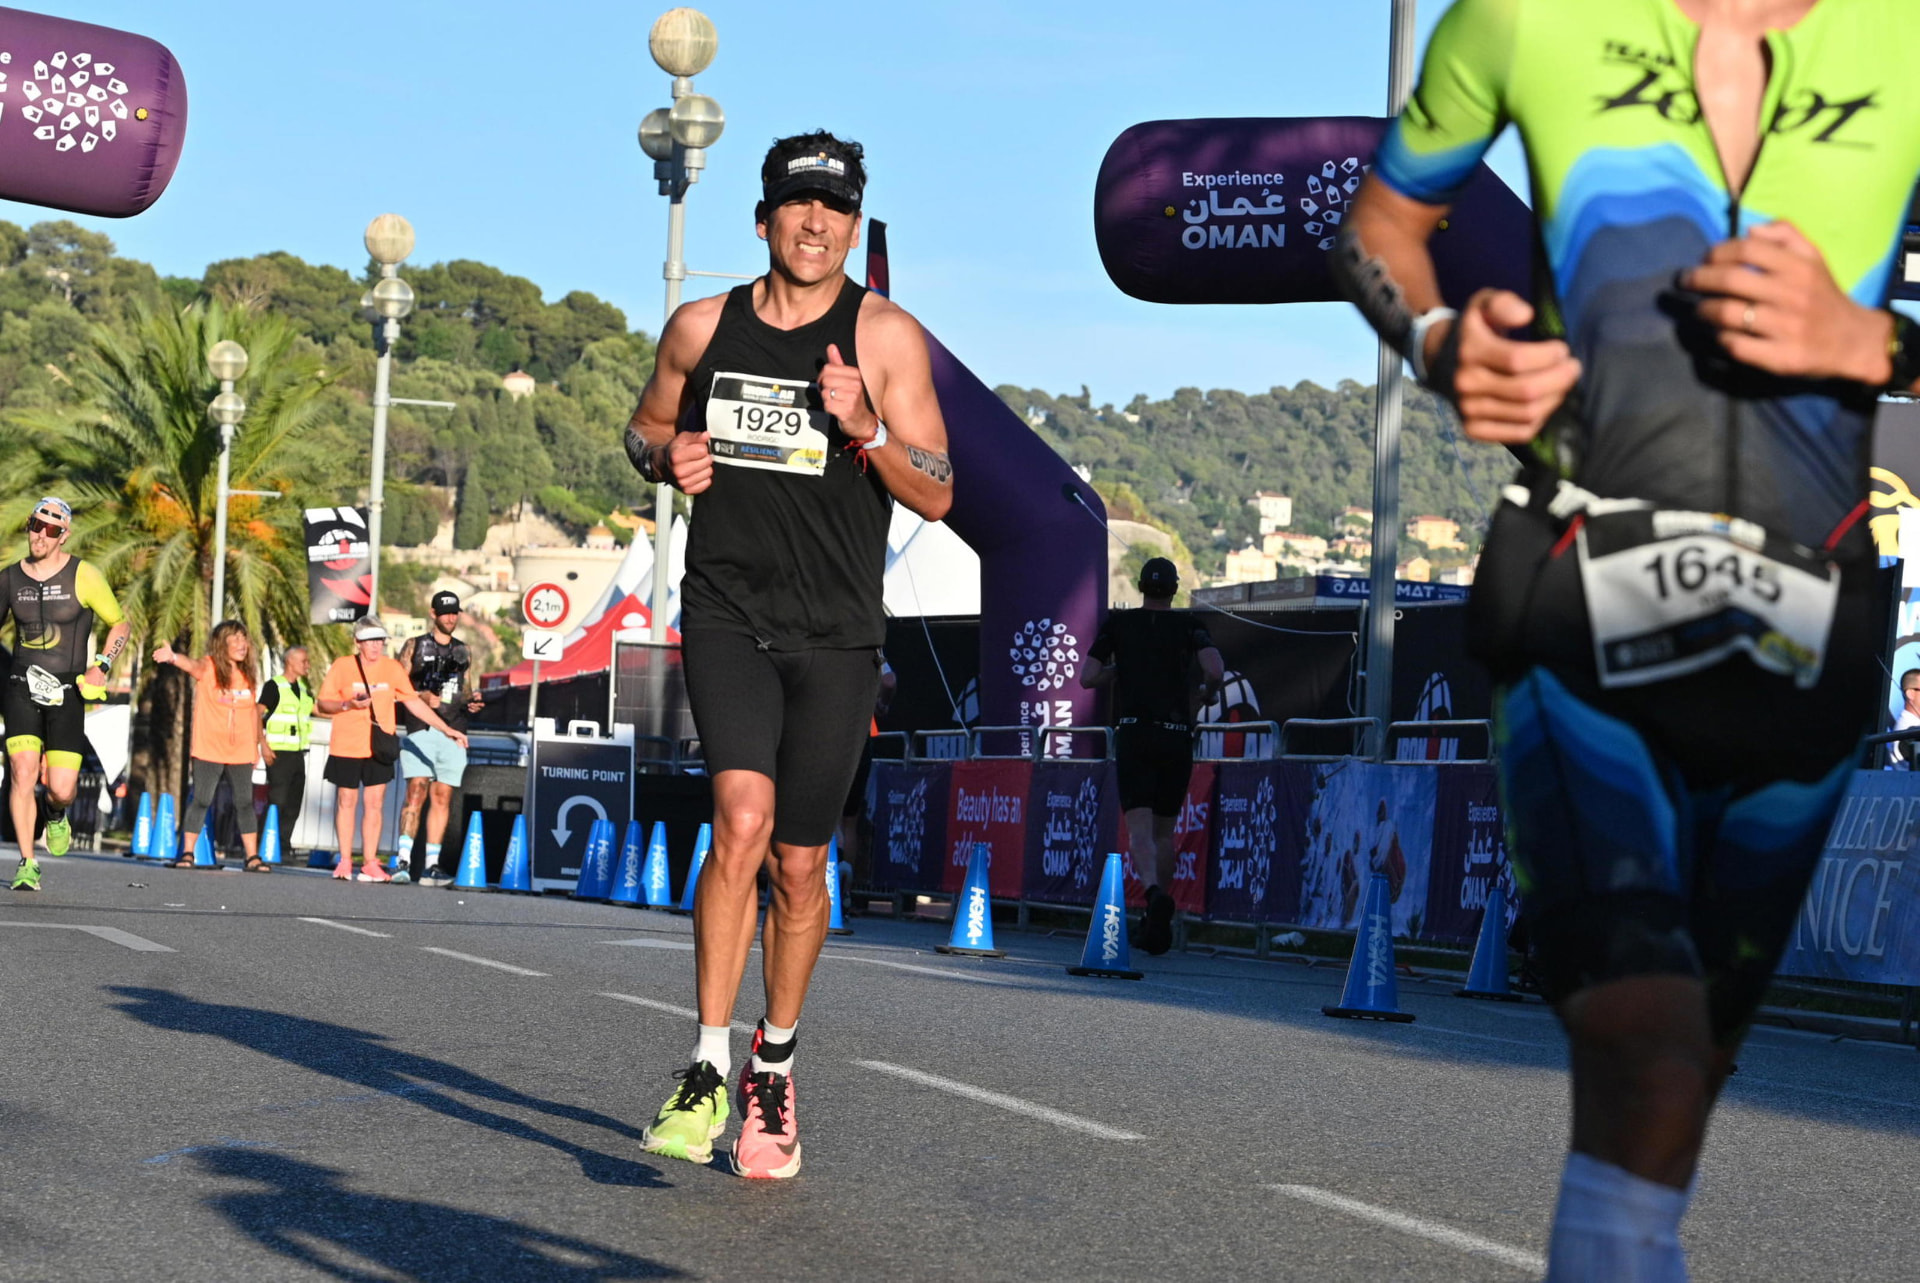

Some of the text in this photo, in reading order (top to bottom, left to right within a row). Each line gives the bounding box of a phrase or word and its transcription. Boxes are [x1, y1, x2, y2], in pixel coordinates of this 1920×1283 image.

[1182, 171, 1284, 189] Experience
[1182, 223, 1285, 249] OMAN
[733, 405, 802, 436] 1929
[1645, 545, 1782, 603] 1645
[533, 599, 561, 611] 2,1m
[1055, 700, 1072, 758] MAN
[541, 766, 625, 783] TURNING POINT
[956, 786, 1021, 830] Beauty has an
[1831, 796, 1882, 850] LLE
[469, 832, 481, 869] HOKA
[597, 839, 609, 881] HOKA
[624, 844, 638, 888] HOKA
[652, 844, 665, 889] HOKA
[967, 886, 985, 938] HOKA
[1796, 858, 1903, 956] NICE
[1102, 904, 1120, 960] HOKA
[1367, 914, 1388, 987] HOKA
